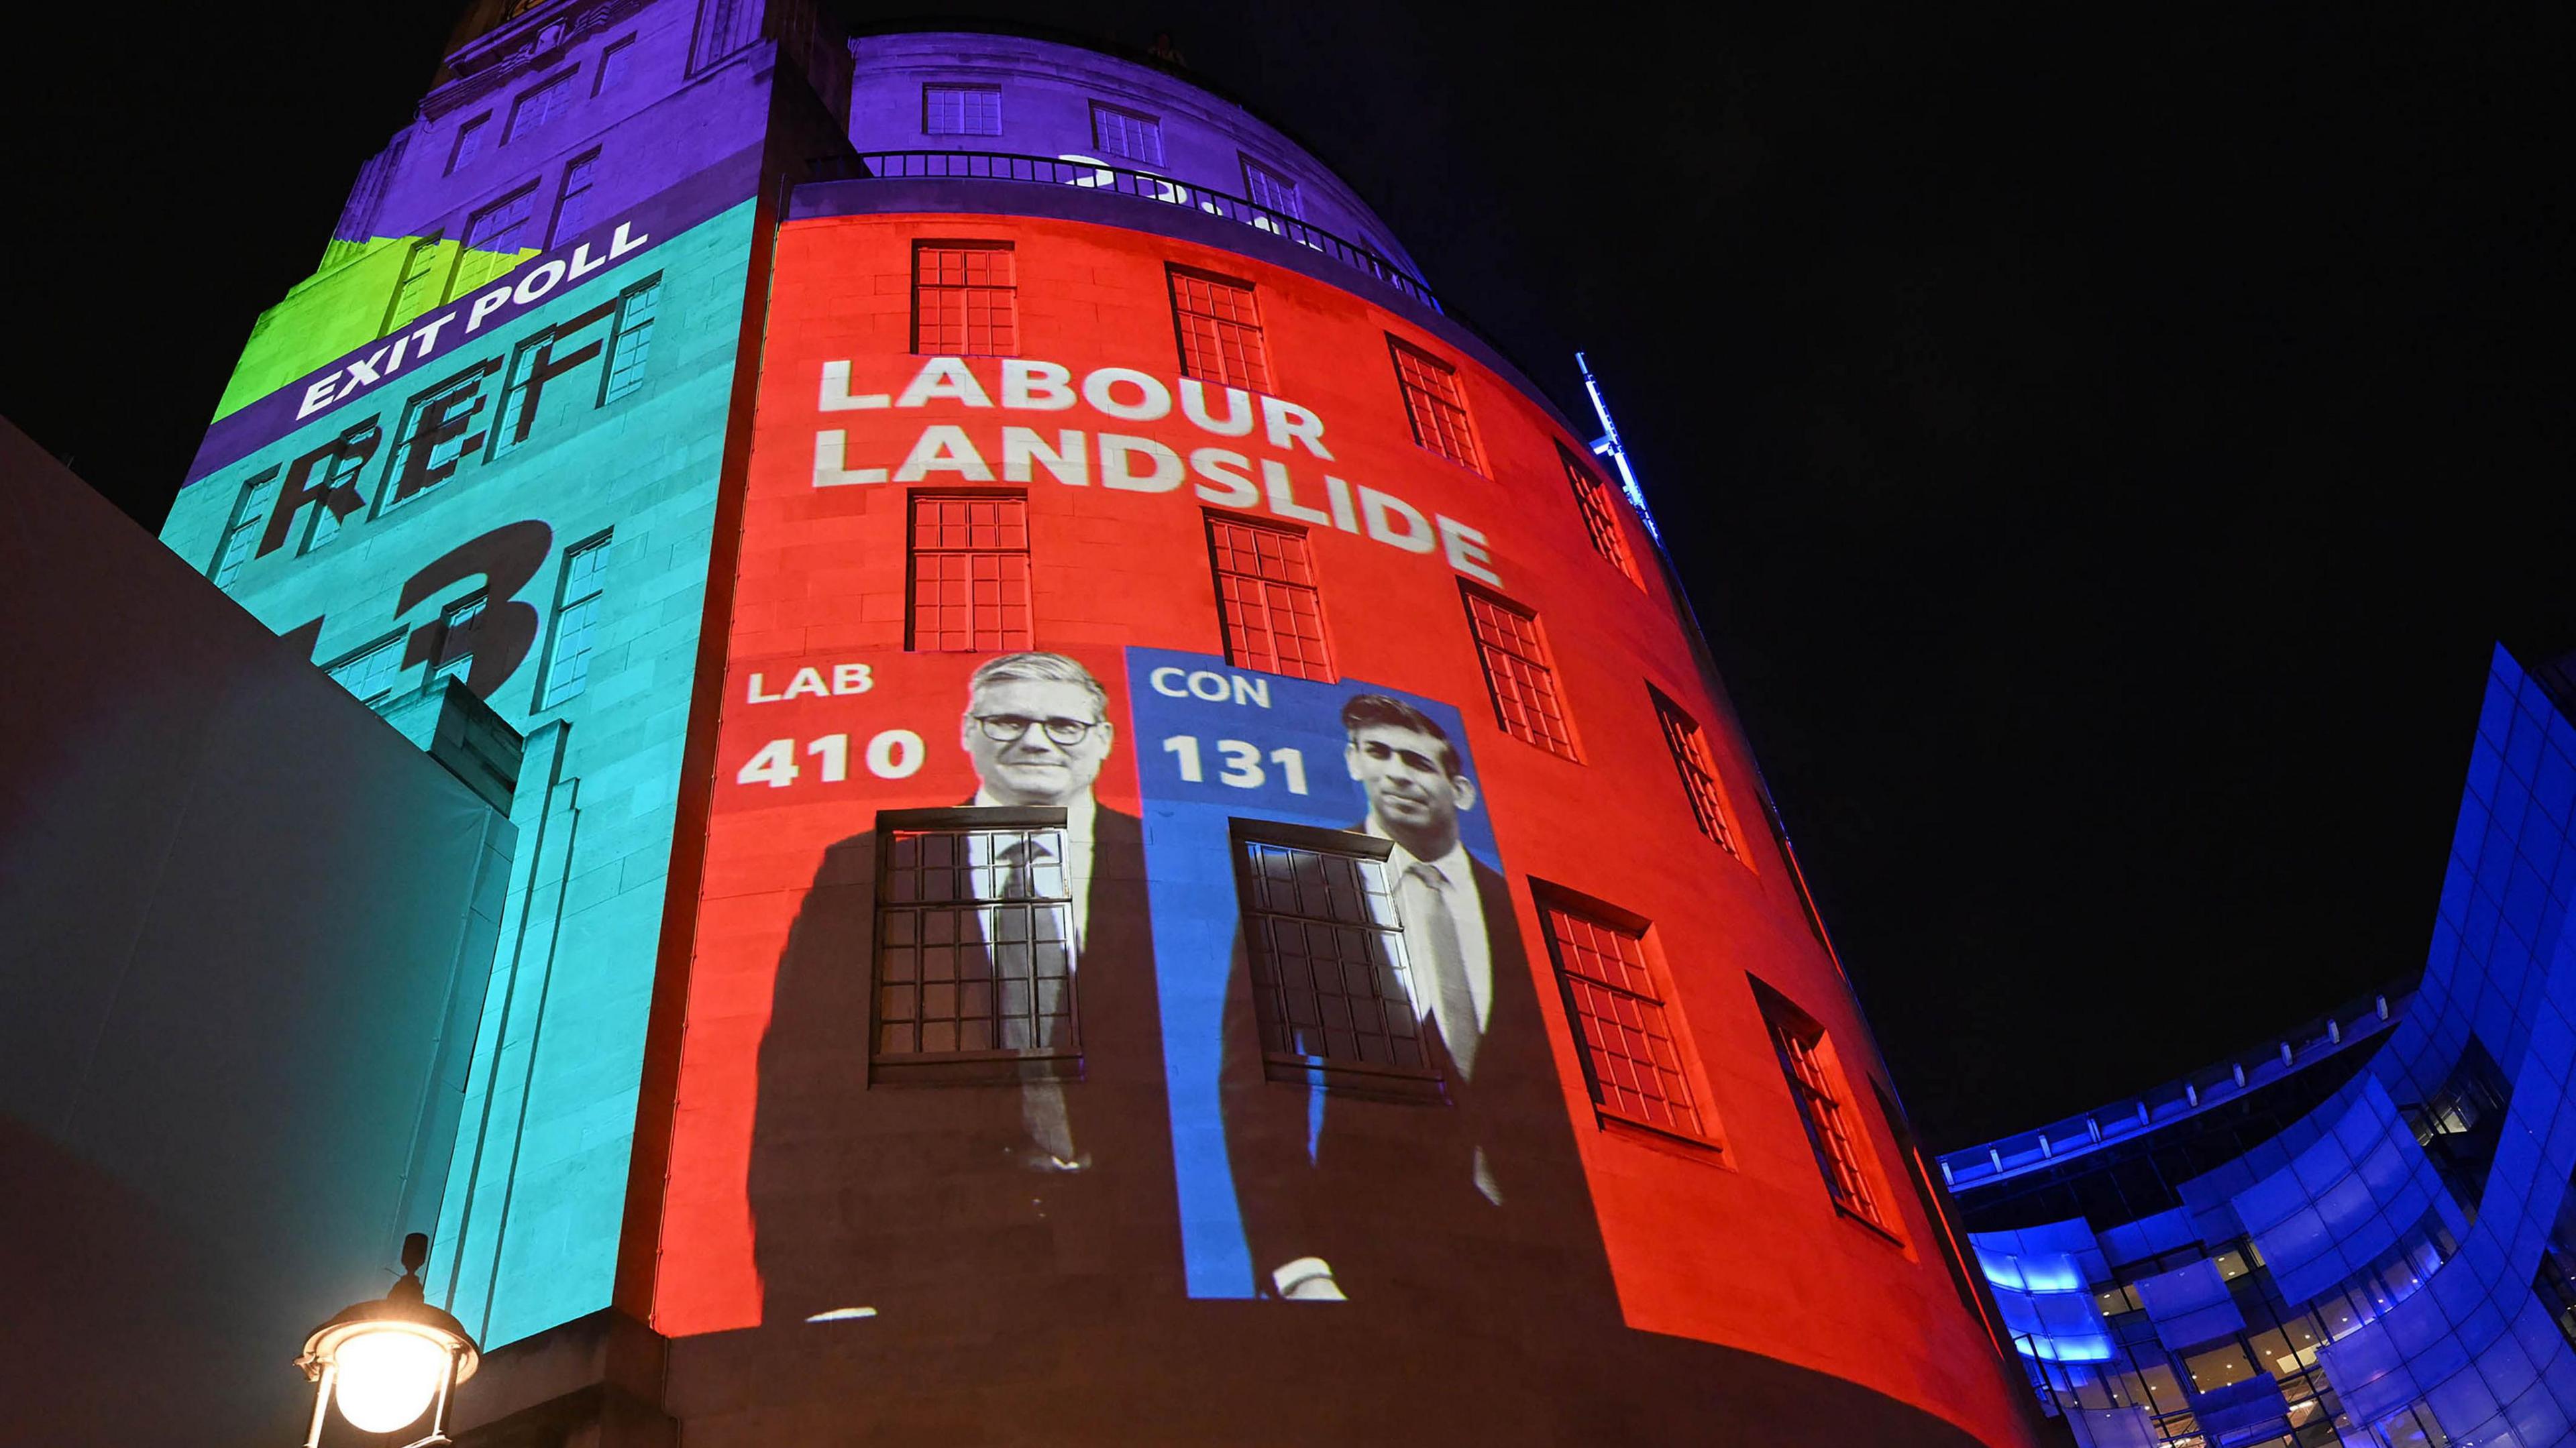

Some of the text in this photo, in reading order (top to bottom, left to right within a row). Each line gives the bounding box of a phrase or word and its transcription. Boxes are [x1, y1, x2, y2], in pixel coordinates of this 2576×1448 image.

[294, 220, 649, 422] EXIT POLL
[255, 297, 621, 559] REF
[817, 356, 1335, 461] LABOUR
[811, 425, 1503, 588] LANDSLIDE
[747, 663, 874, 704] LAB
[1150, 665, 1272, 709] CON
[736, 728, 926, 789] 410
[1163, 734, 1309, 796] 131
